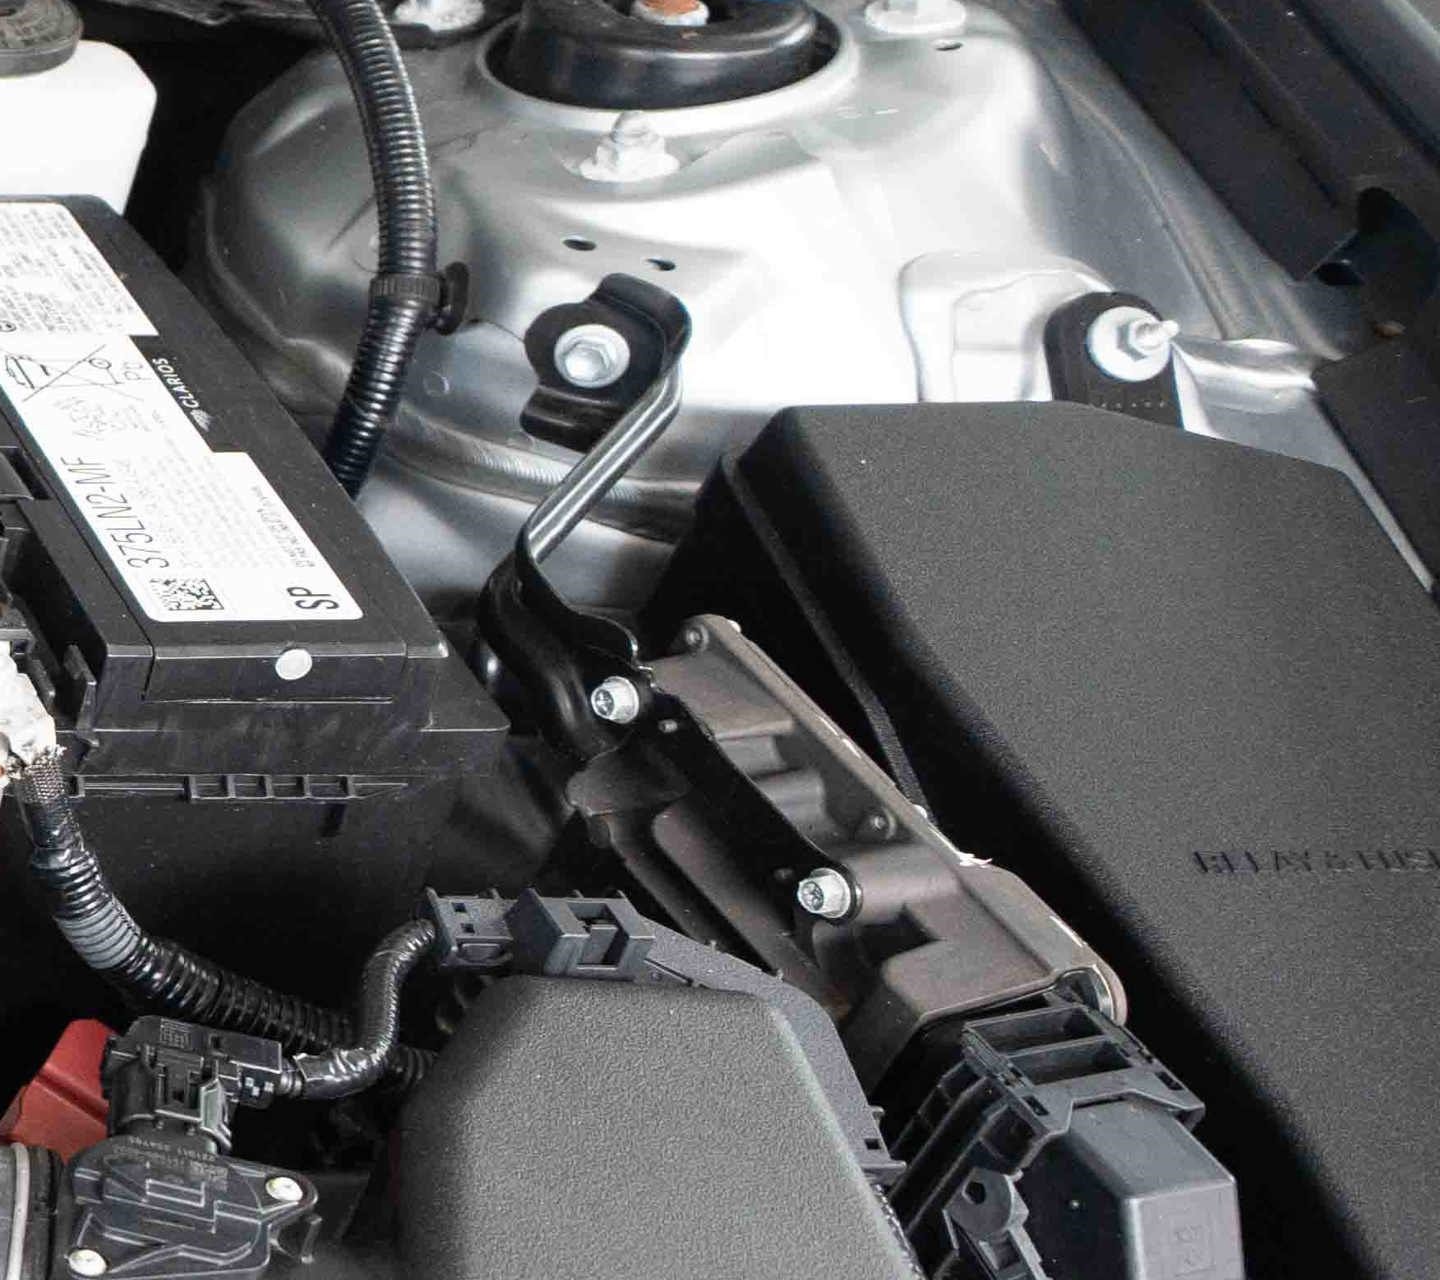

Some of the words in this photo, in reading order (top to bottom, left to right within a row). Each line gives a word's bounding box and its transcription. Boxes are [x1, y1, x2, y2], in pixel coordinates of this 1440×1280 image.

[152, 357, 199, 409] CLARIOS
[59, 456, 170, 568] 375LN2-MF
[286, 585, 340, 610] SP
